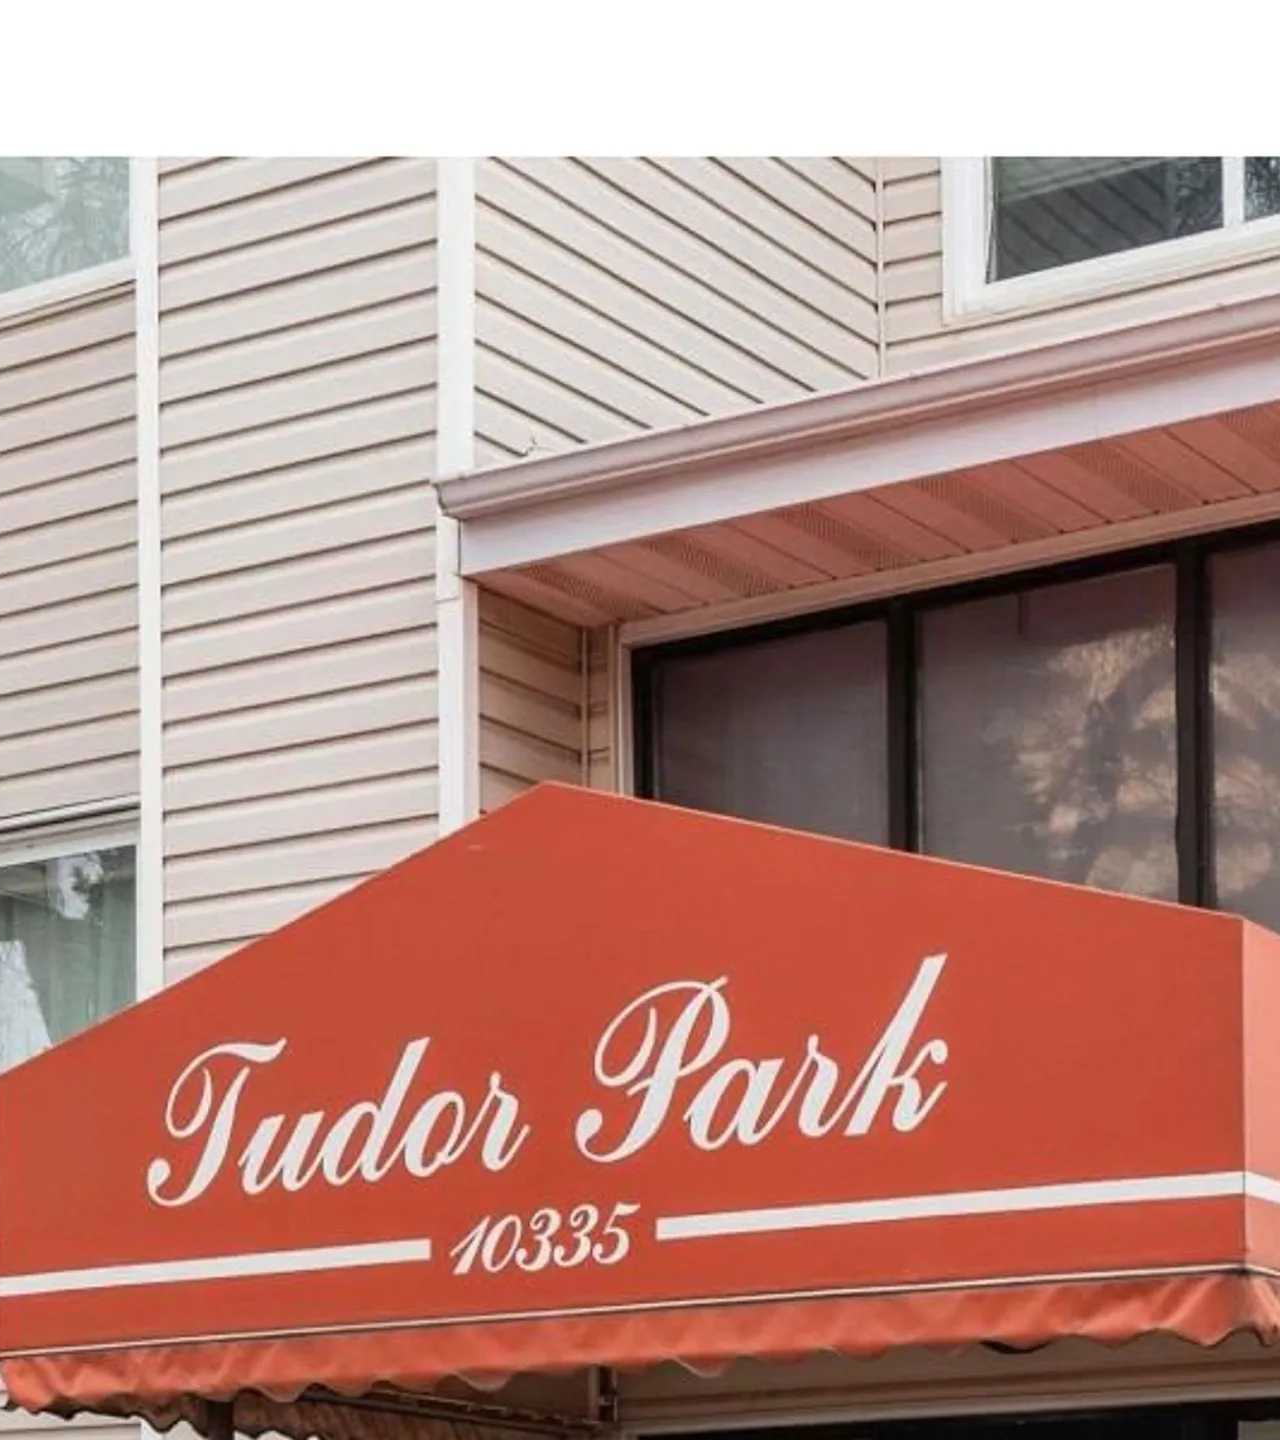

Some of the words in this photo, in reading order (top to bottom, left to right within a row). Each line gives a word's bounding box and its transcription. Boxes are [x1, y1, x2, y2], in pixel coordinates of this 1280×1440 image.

[147, 1037, 529, 1207] Tudor
[575, 953, 948, 1163] Park
[450, 1203, 640, 1275] 10335
